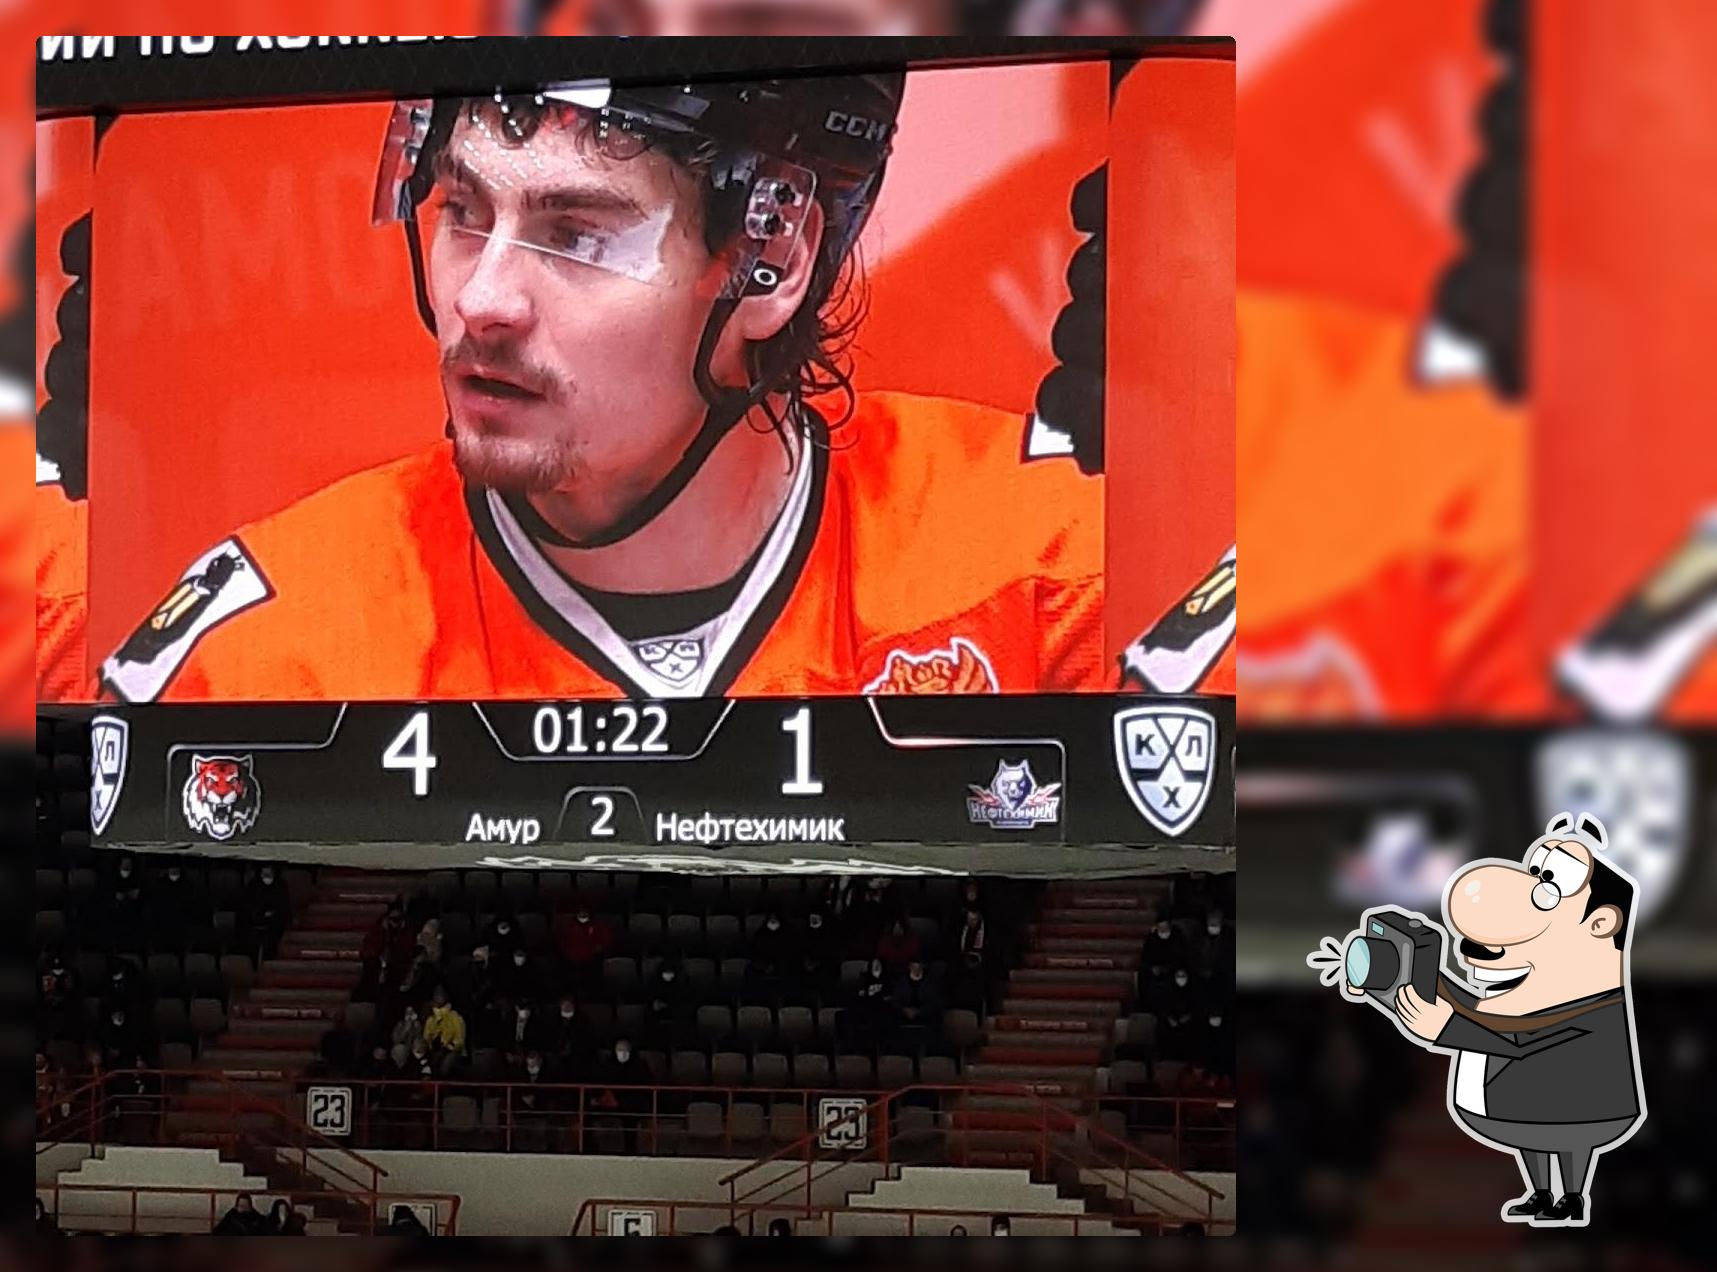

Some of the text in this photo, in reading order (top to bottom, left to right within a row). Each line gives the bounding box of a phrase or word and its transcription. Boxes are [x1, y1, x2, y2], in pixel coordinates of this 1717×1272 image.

[534, 705, 669, 753] 01:22
[383, 711, 436, 795] 4
[782, 708, 823, 795] 1
[465, 813, 541, 845] Амур
[591, 796, 614, 836] 2
[656, 812, 845, 844] Нефтехимик
[313, 1094, 346, 1128] 23
[826, 1106, 860, 1140] 23
